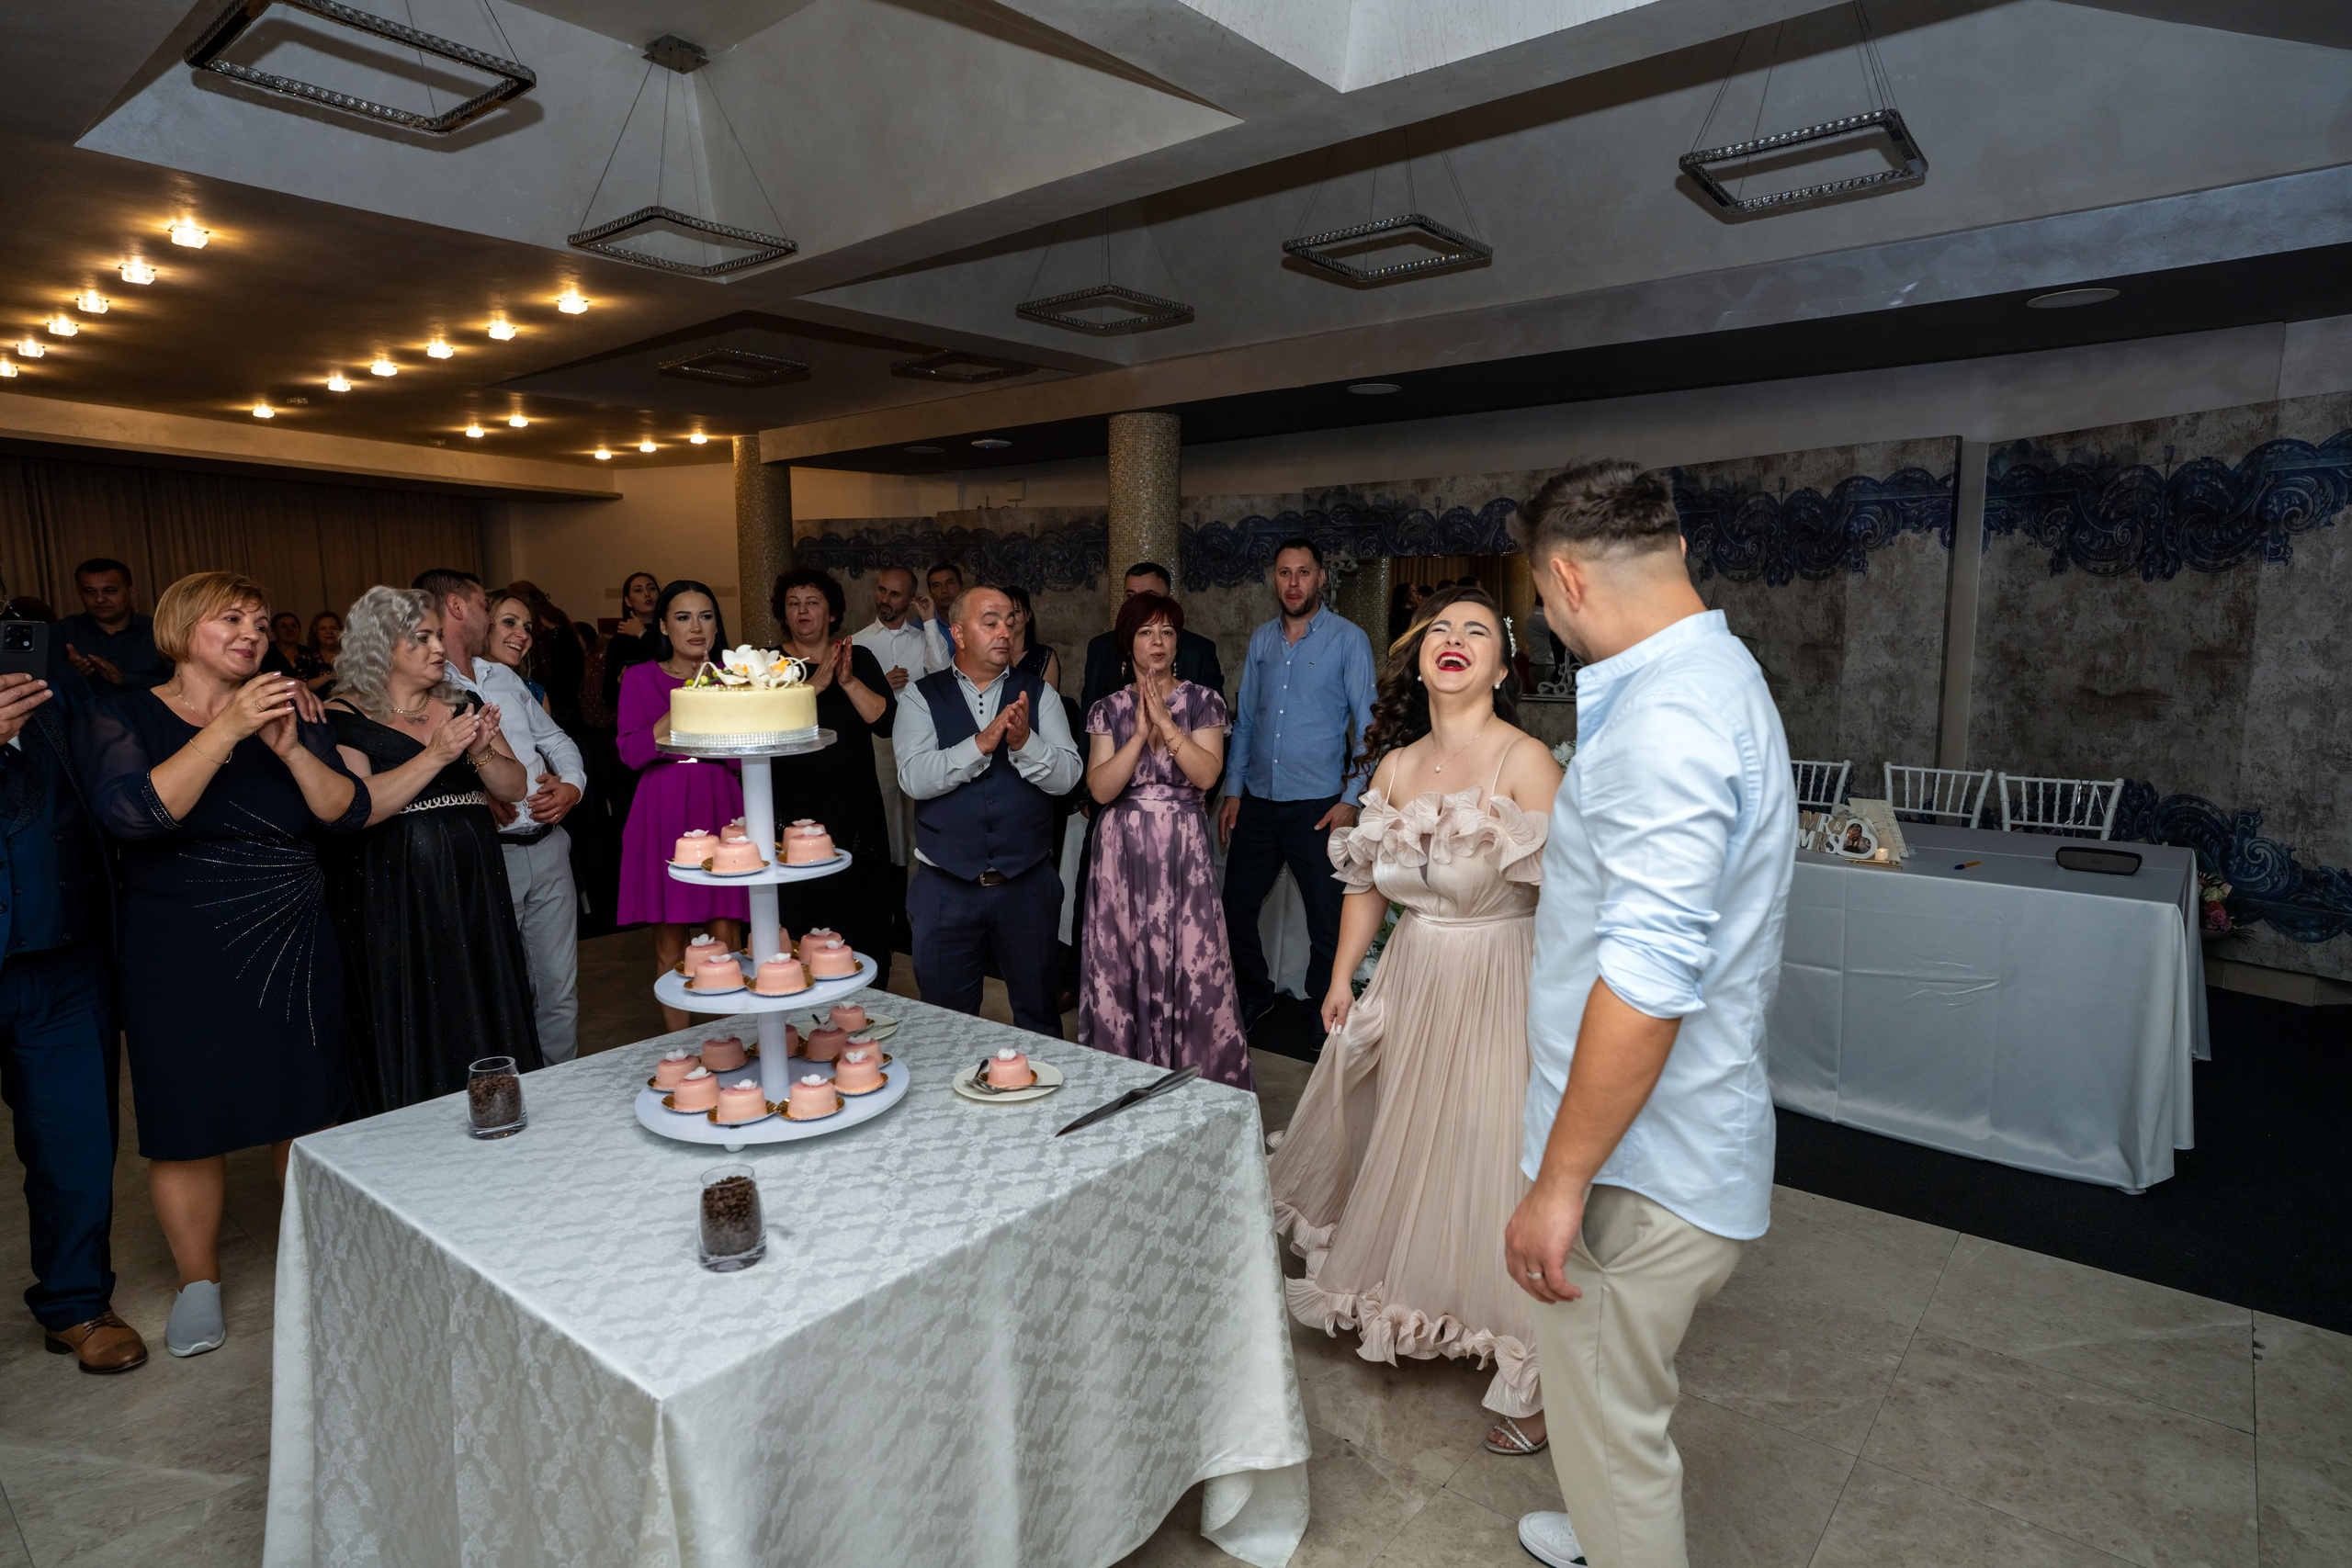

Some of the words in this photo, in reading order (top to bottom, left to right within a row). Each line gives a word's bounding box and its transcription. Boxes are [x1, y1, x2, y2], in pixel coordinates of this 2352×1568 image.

[1799, 810, 1835, 834] MR
[1833, 820, 1842, 831] &
[1797, 829, 1839, 854] MRS
